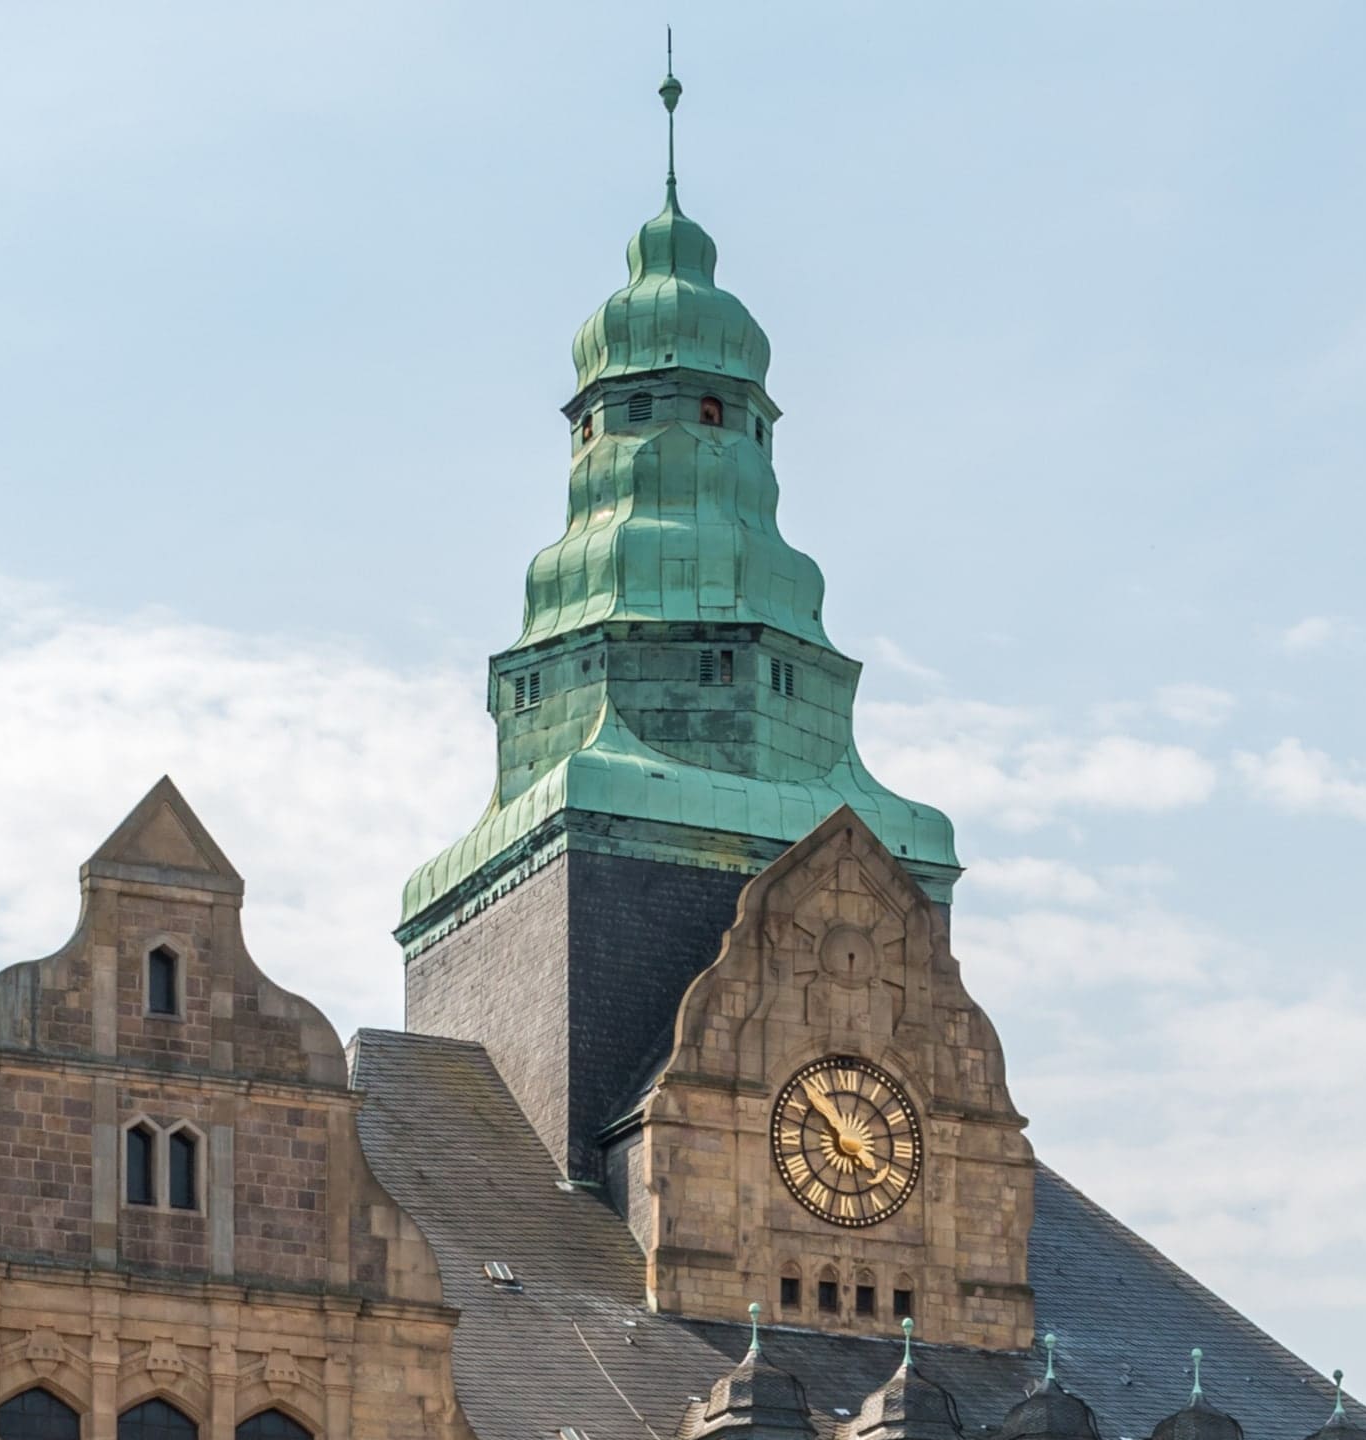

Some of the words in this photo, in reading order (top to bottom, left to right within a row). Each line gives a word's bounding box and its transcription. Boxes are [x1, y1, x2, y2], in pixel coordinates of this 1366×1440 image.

[838, 1069, 857, 1091] XII
[870, 1083, 882, 1100] I
[886, 1109, 906, 1125] II
[894, 1141, 913, 1159] III
[807, 1180, 829, 1208] VII
[870, 1192, 885, 1212] V
[841, 1196, 855, 1217] VI
